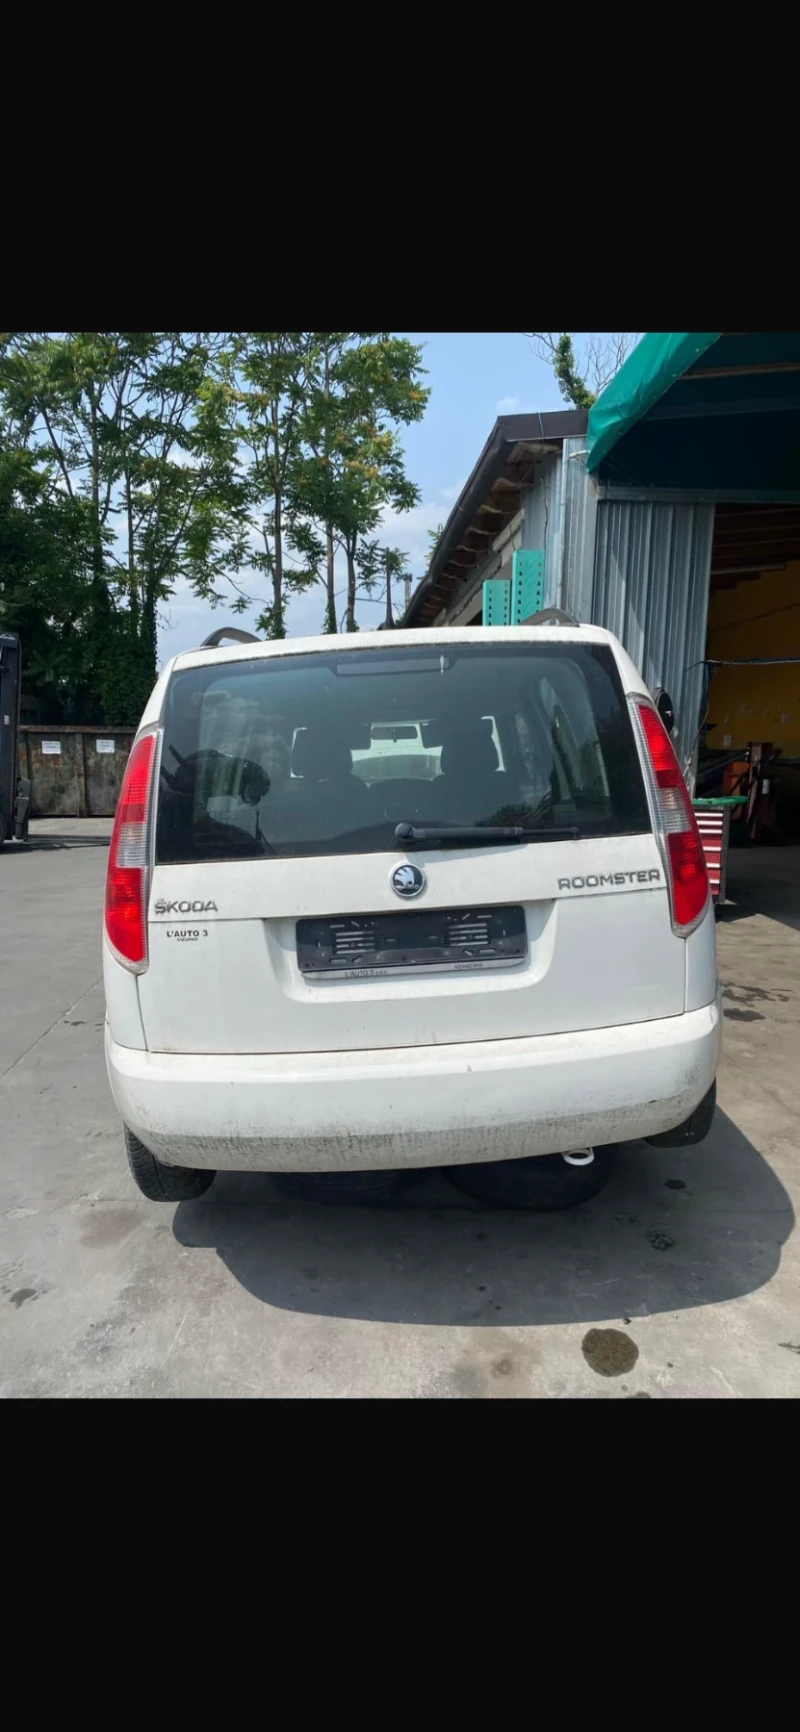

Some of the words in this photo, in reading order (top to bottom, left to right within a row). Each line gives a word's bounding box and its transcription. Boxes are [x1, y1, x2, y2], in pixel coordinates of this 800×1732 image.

[557, 869, 660, 890] ROOMSTER
[154, 898, 218, 914] ŠKODA
[166, 930, 200, 938] L'AUTO
[202, 929, 209, 937] 3
